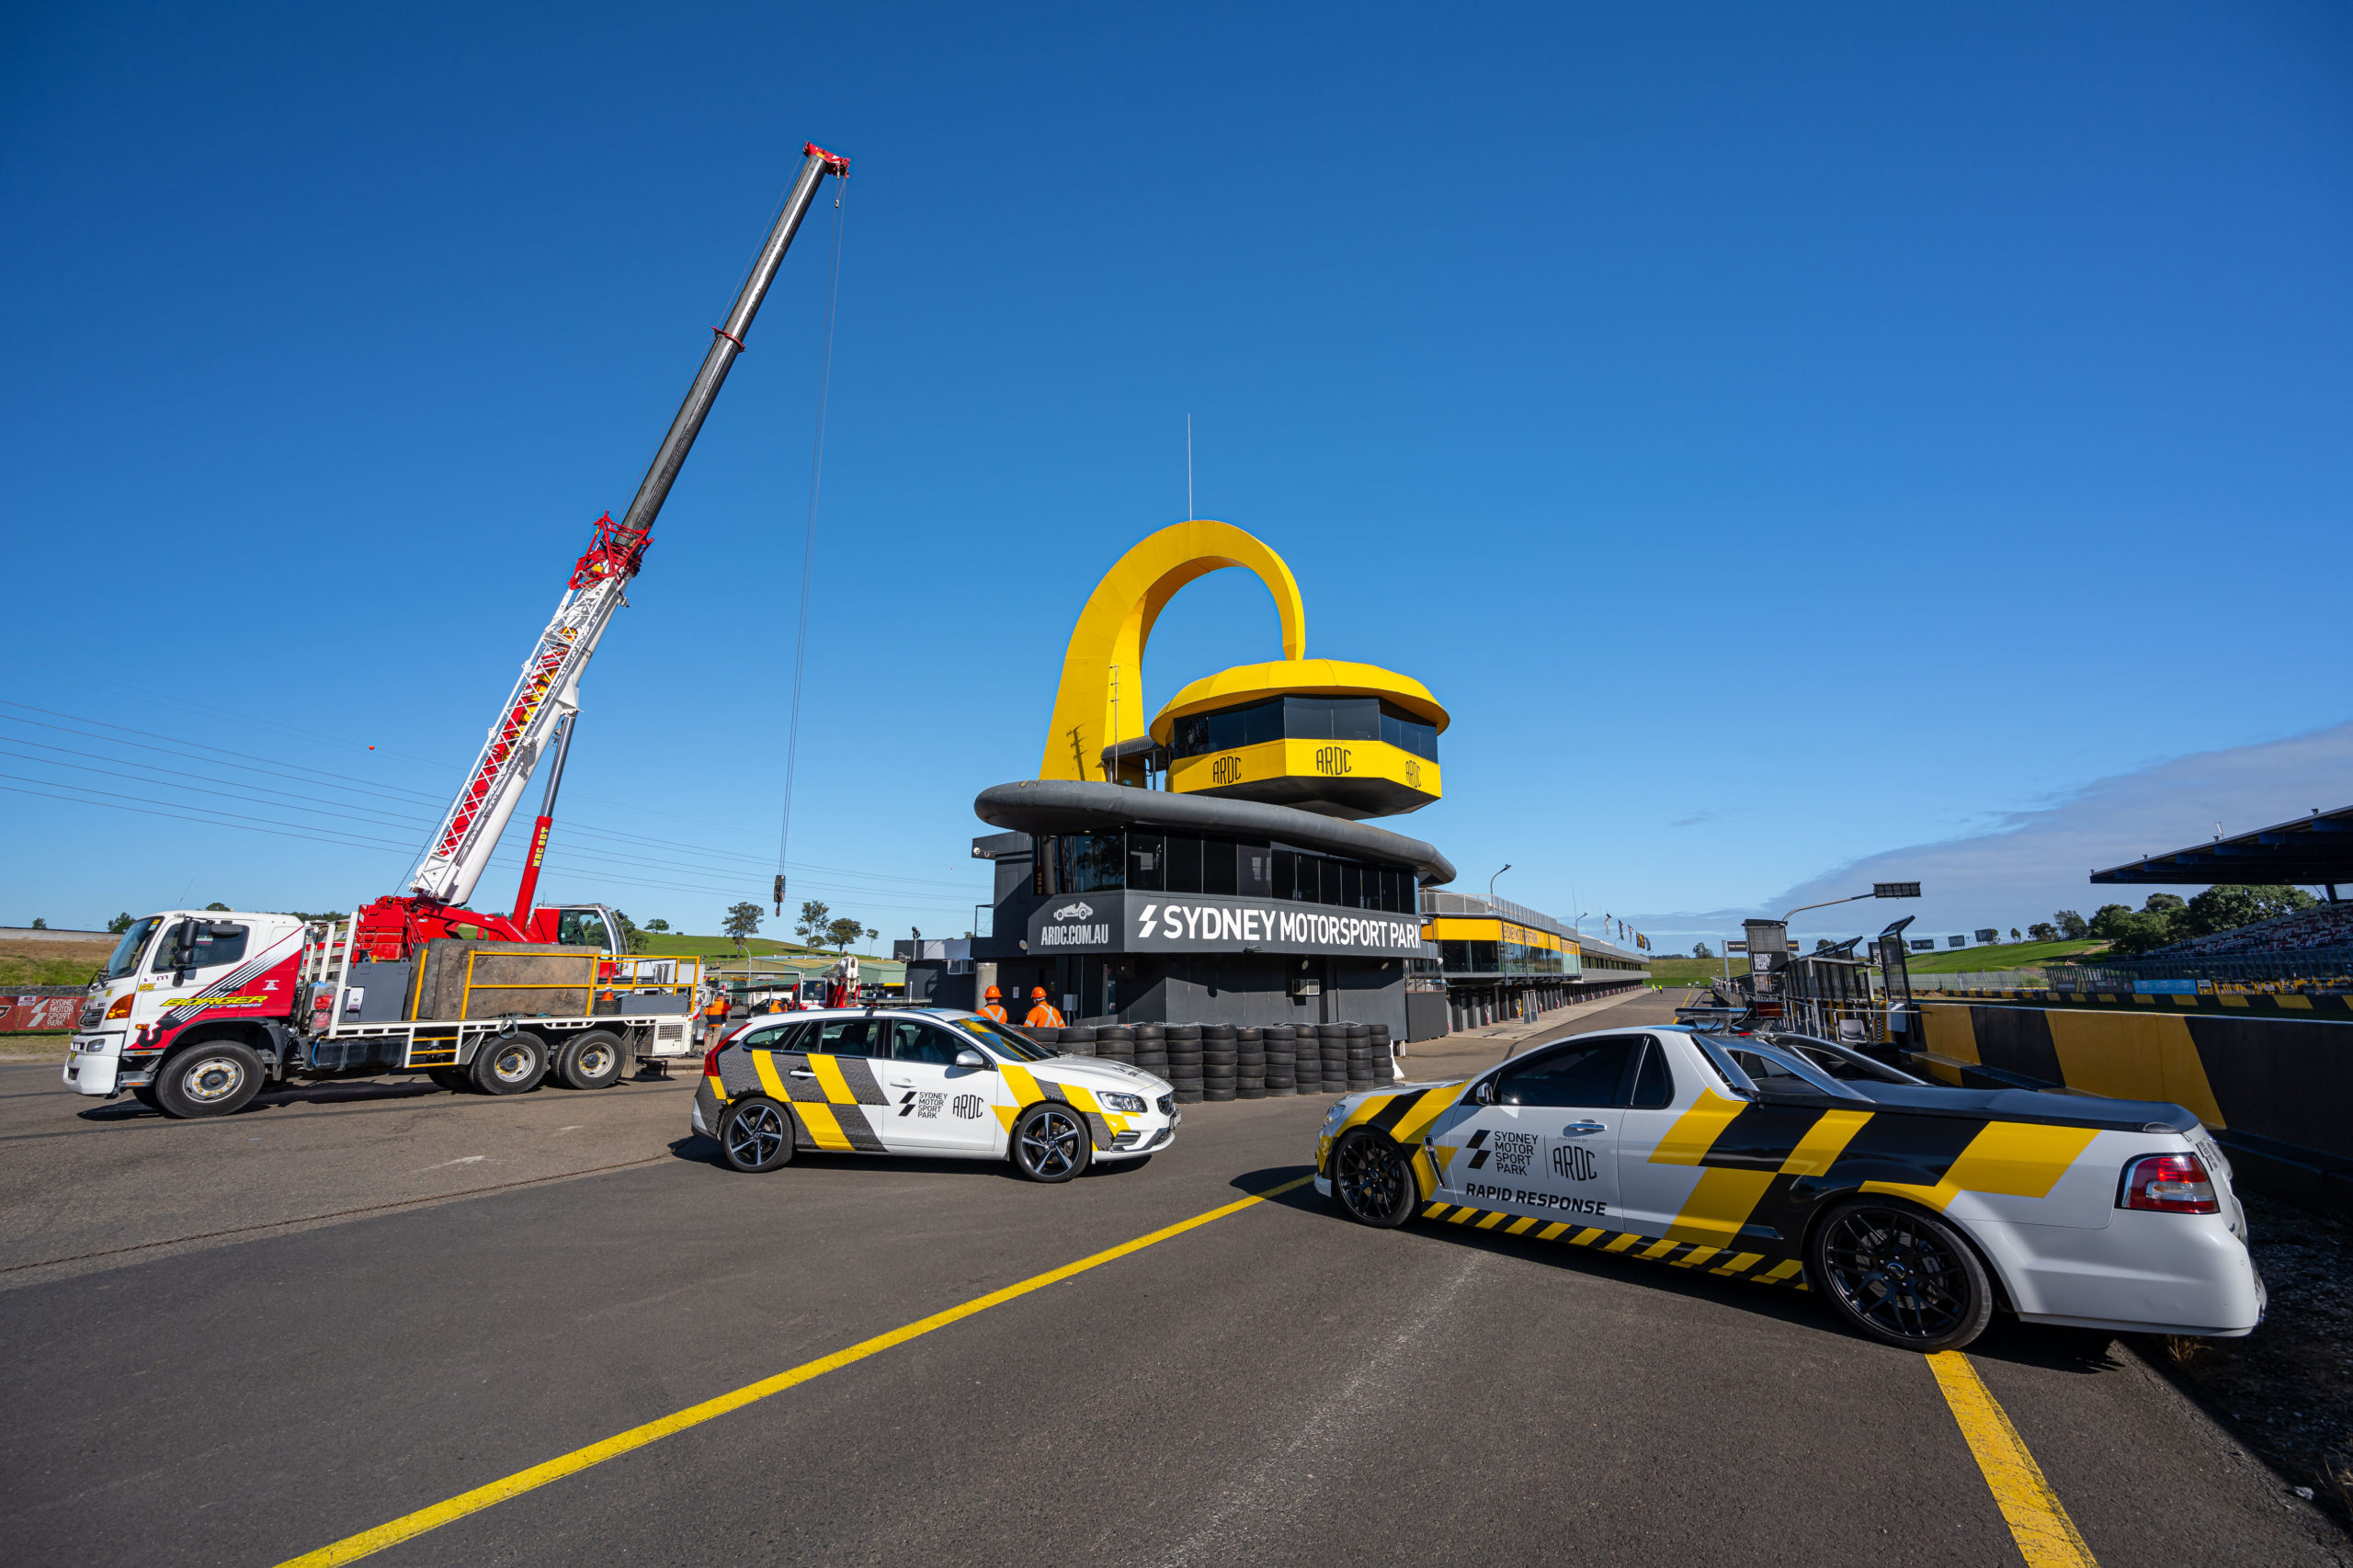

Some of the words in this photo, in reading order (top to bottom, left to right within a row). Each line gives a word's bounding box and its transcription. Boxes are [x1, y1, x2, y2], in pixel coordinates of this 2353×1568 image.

[1316, 746, 1352, 776] ARDC
[1212, 756, 1242, 785] ARDC
[1405, 759, 1421, 789] ARDC
[1163, 904, 1277, 940] SYDNEY
[1280, 911, 1387, 948] MOTORSPORT
[1390, 922, 1422, 949] PARK
[1040, 924, 1108, 946] ARDC.COM.AU
[51, 998, 78, 1006] SYDNEY
[160, 995, 268, 1006] BORGER
[46, 1018, 64, 1027] PARK
[918, 1098, 944, 1107] MOTOR
[919, 1091, 948, 1100] SYDNEY
[918, 1105, 941, 1113] SPORT
[952, 1094, 983, 1119] ARDC
[917, 1111, 938, 1119] PARK
[1494, 1131, 1539, 1144] SYDNEY
[1495, 1142, 1534, 1156] MOTOR
[1495, 1152, 1531, 1165] SPORT
[1552, 1145, 1597, 1181] ARDC
[1496, 1162, 1528, 1176] PARK
[1465, 1183, 1512, 1202] RAPID
[1515, 1189, 1608, 1217] RESPONSE
